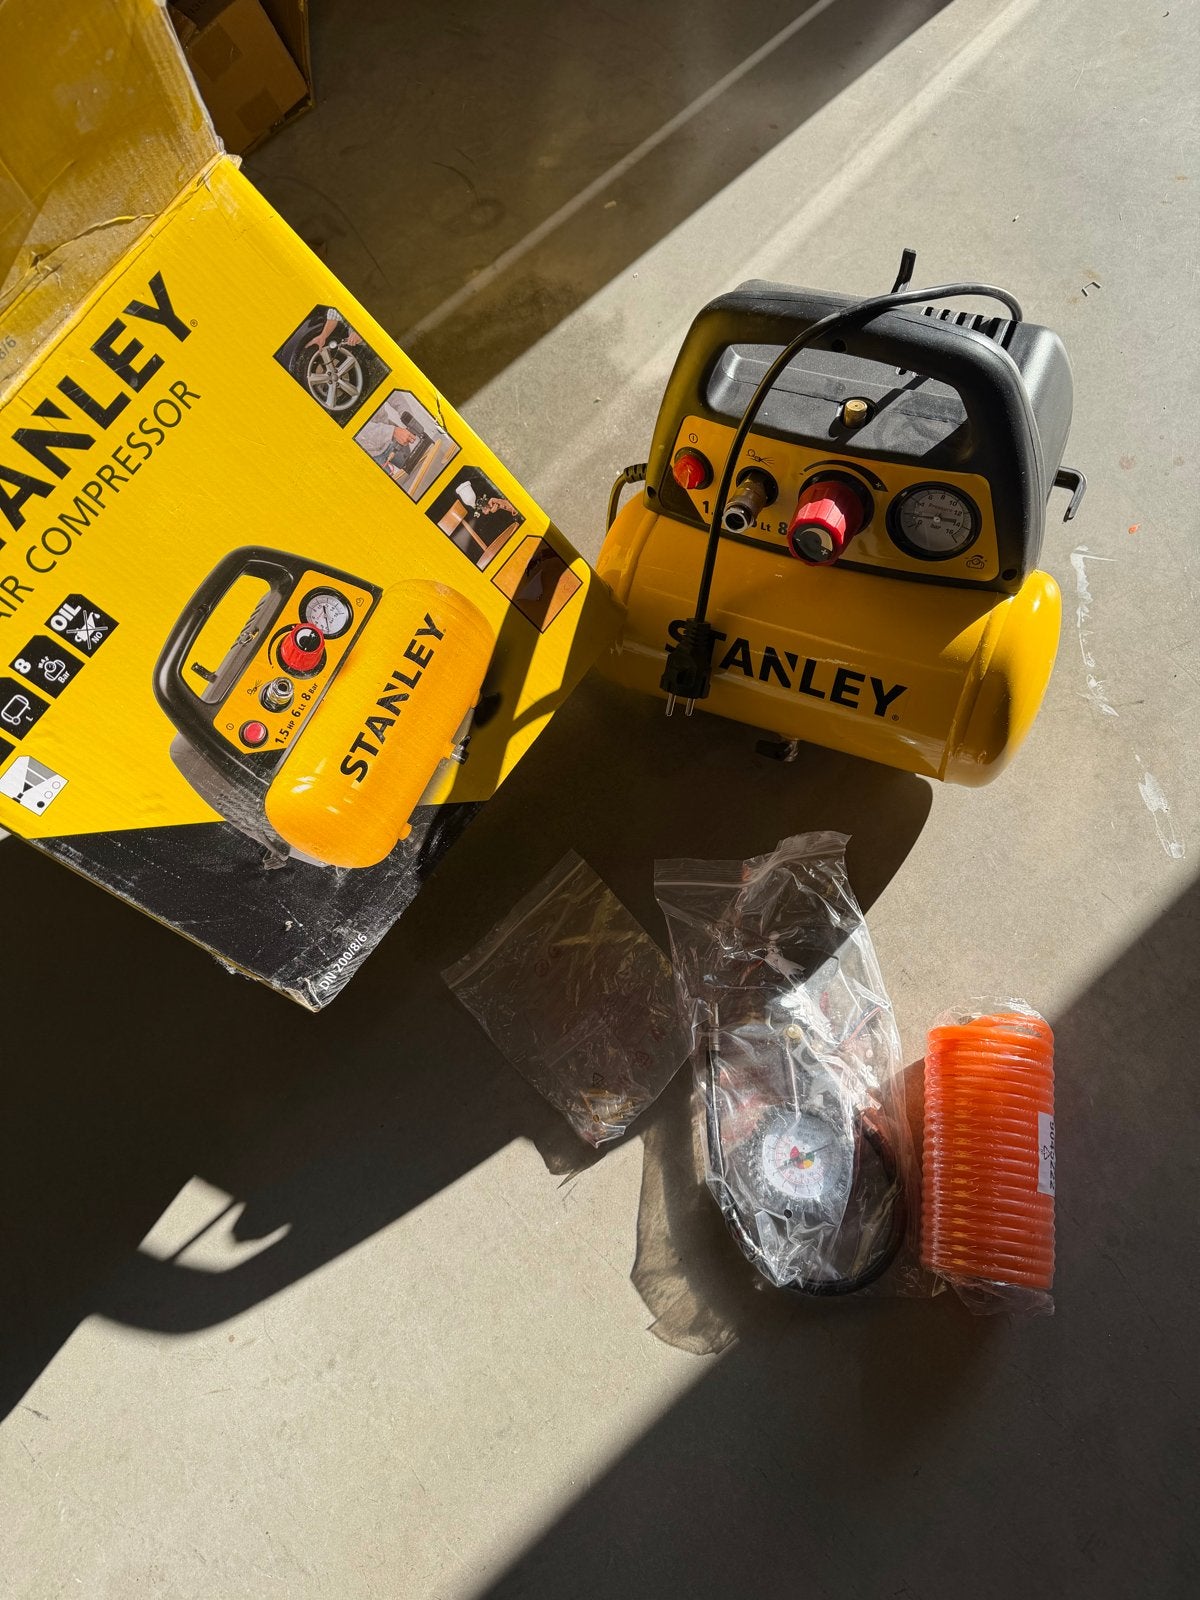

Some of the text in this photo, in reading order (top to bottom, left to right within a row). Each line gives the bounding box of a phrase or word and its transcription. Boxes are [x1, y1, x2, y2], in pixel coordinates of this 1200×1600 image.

[0, 270, 192, 551] ANLEY
[0, 380, 201, 622] IR COMPRESSOR
[760, 522, 771, 532] Lt
[778, 521, 788, 536] 8
[50, 603, 82, 632] OIL
[91, 631, 103, 644] NO
[14, 658, 32, 674] 8
[57, 670, 71, 684] Bar
[275, 728, 290, 744] 1.5
[286, 720, 296, 730] HP
[291, 709, 301, 718] 6
[301, 692, 312, 701] 8
[308, 683, 319, 694] Bar
[339, 612, 446, 784] STANLEY
[319, 932, 368, 991] DN 200/8/6
